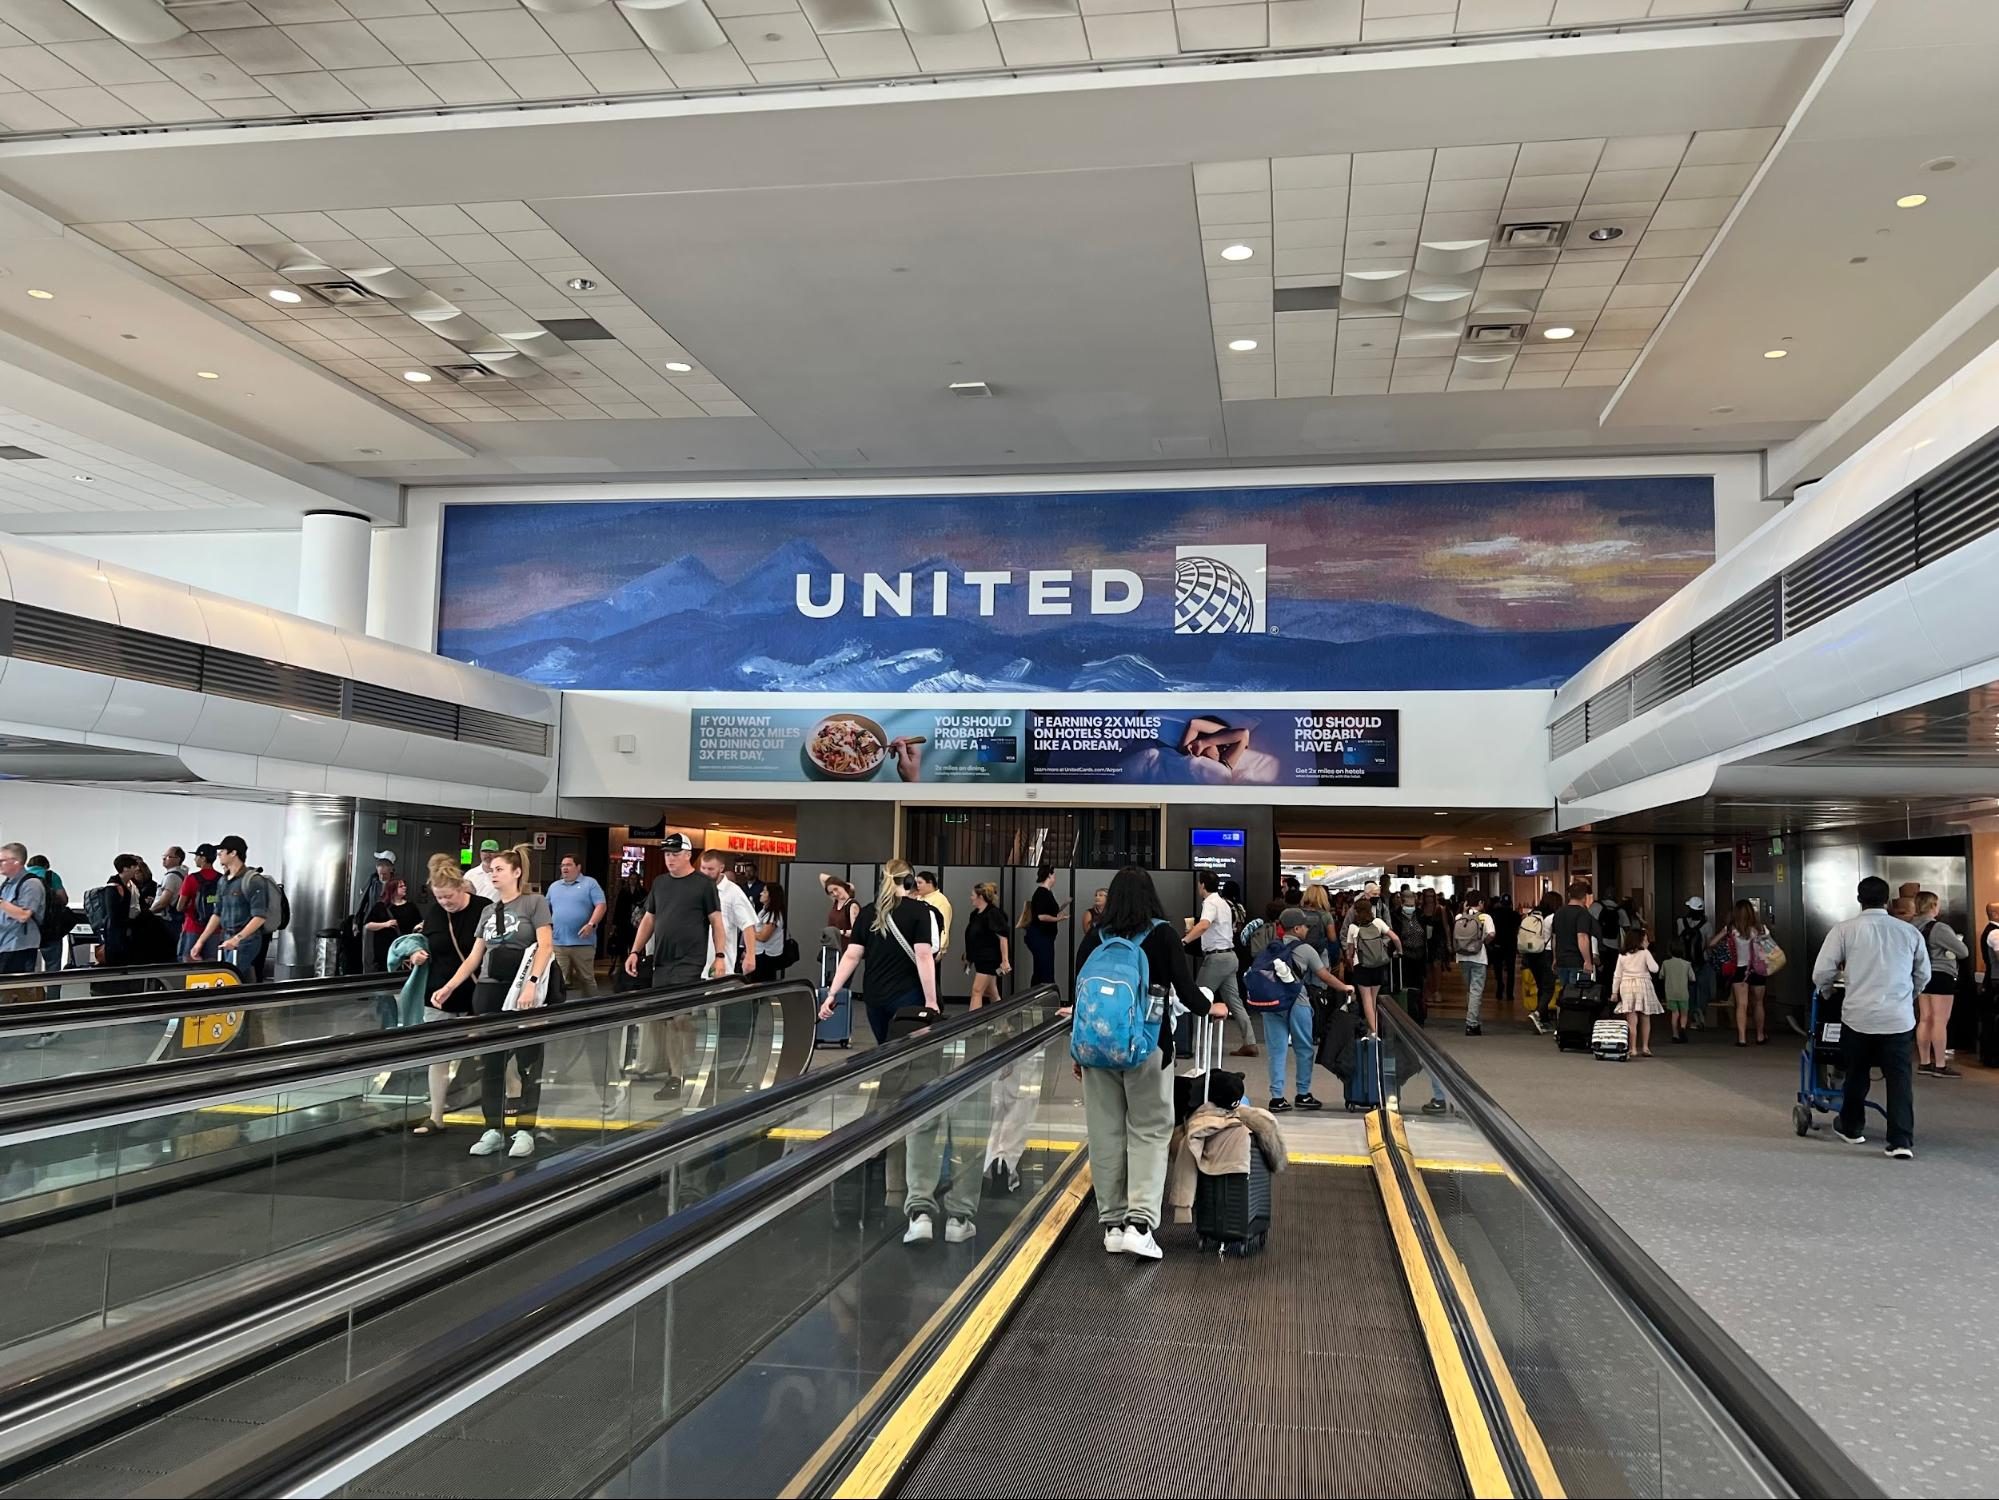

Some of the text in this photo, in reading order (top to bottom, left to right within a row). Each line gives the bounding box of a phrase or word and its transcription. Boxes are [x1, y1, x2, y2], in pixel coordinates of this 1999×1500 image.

[796, 568, 1144, 618] UNITED
[700, 716, 771, 726] IF YOU WANT
[934, 716, 1012, 727] YOU SHOULD
[1033, 716, 1161, 727] IF EARNING 2X MILES
[1294, 716, 1382, 728] YOU SHOULD
[700, 727, 800, 738] TO EARN 2X MILES
[934, 728, 997, 738] PROBABLY
[1033, 728, 1159, 739] ON HOTELS SOUNDS
[1294, 729, 1364, 740] PROBABLY
[700, 738, 785, 749] ON DINING OUT
[934, 739, 968, 750] HAVE
[969, 739, 979, 750] A
[1034, 740, 1122, 753] LIKE A DREAM,
[1294, 741, 1344, 752] HAVE A
[699, 750, 765, 762] 3X PER DAY,
[728, 836, 746, 850] NEW
[746, 838, 776, 853] BELGIUM
